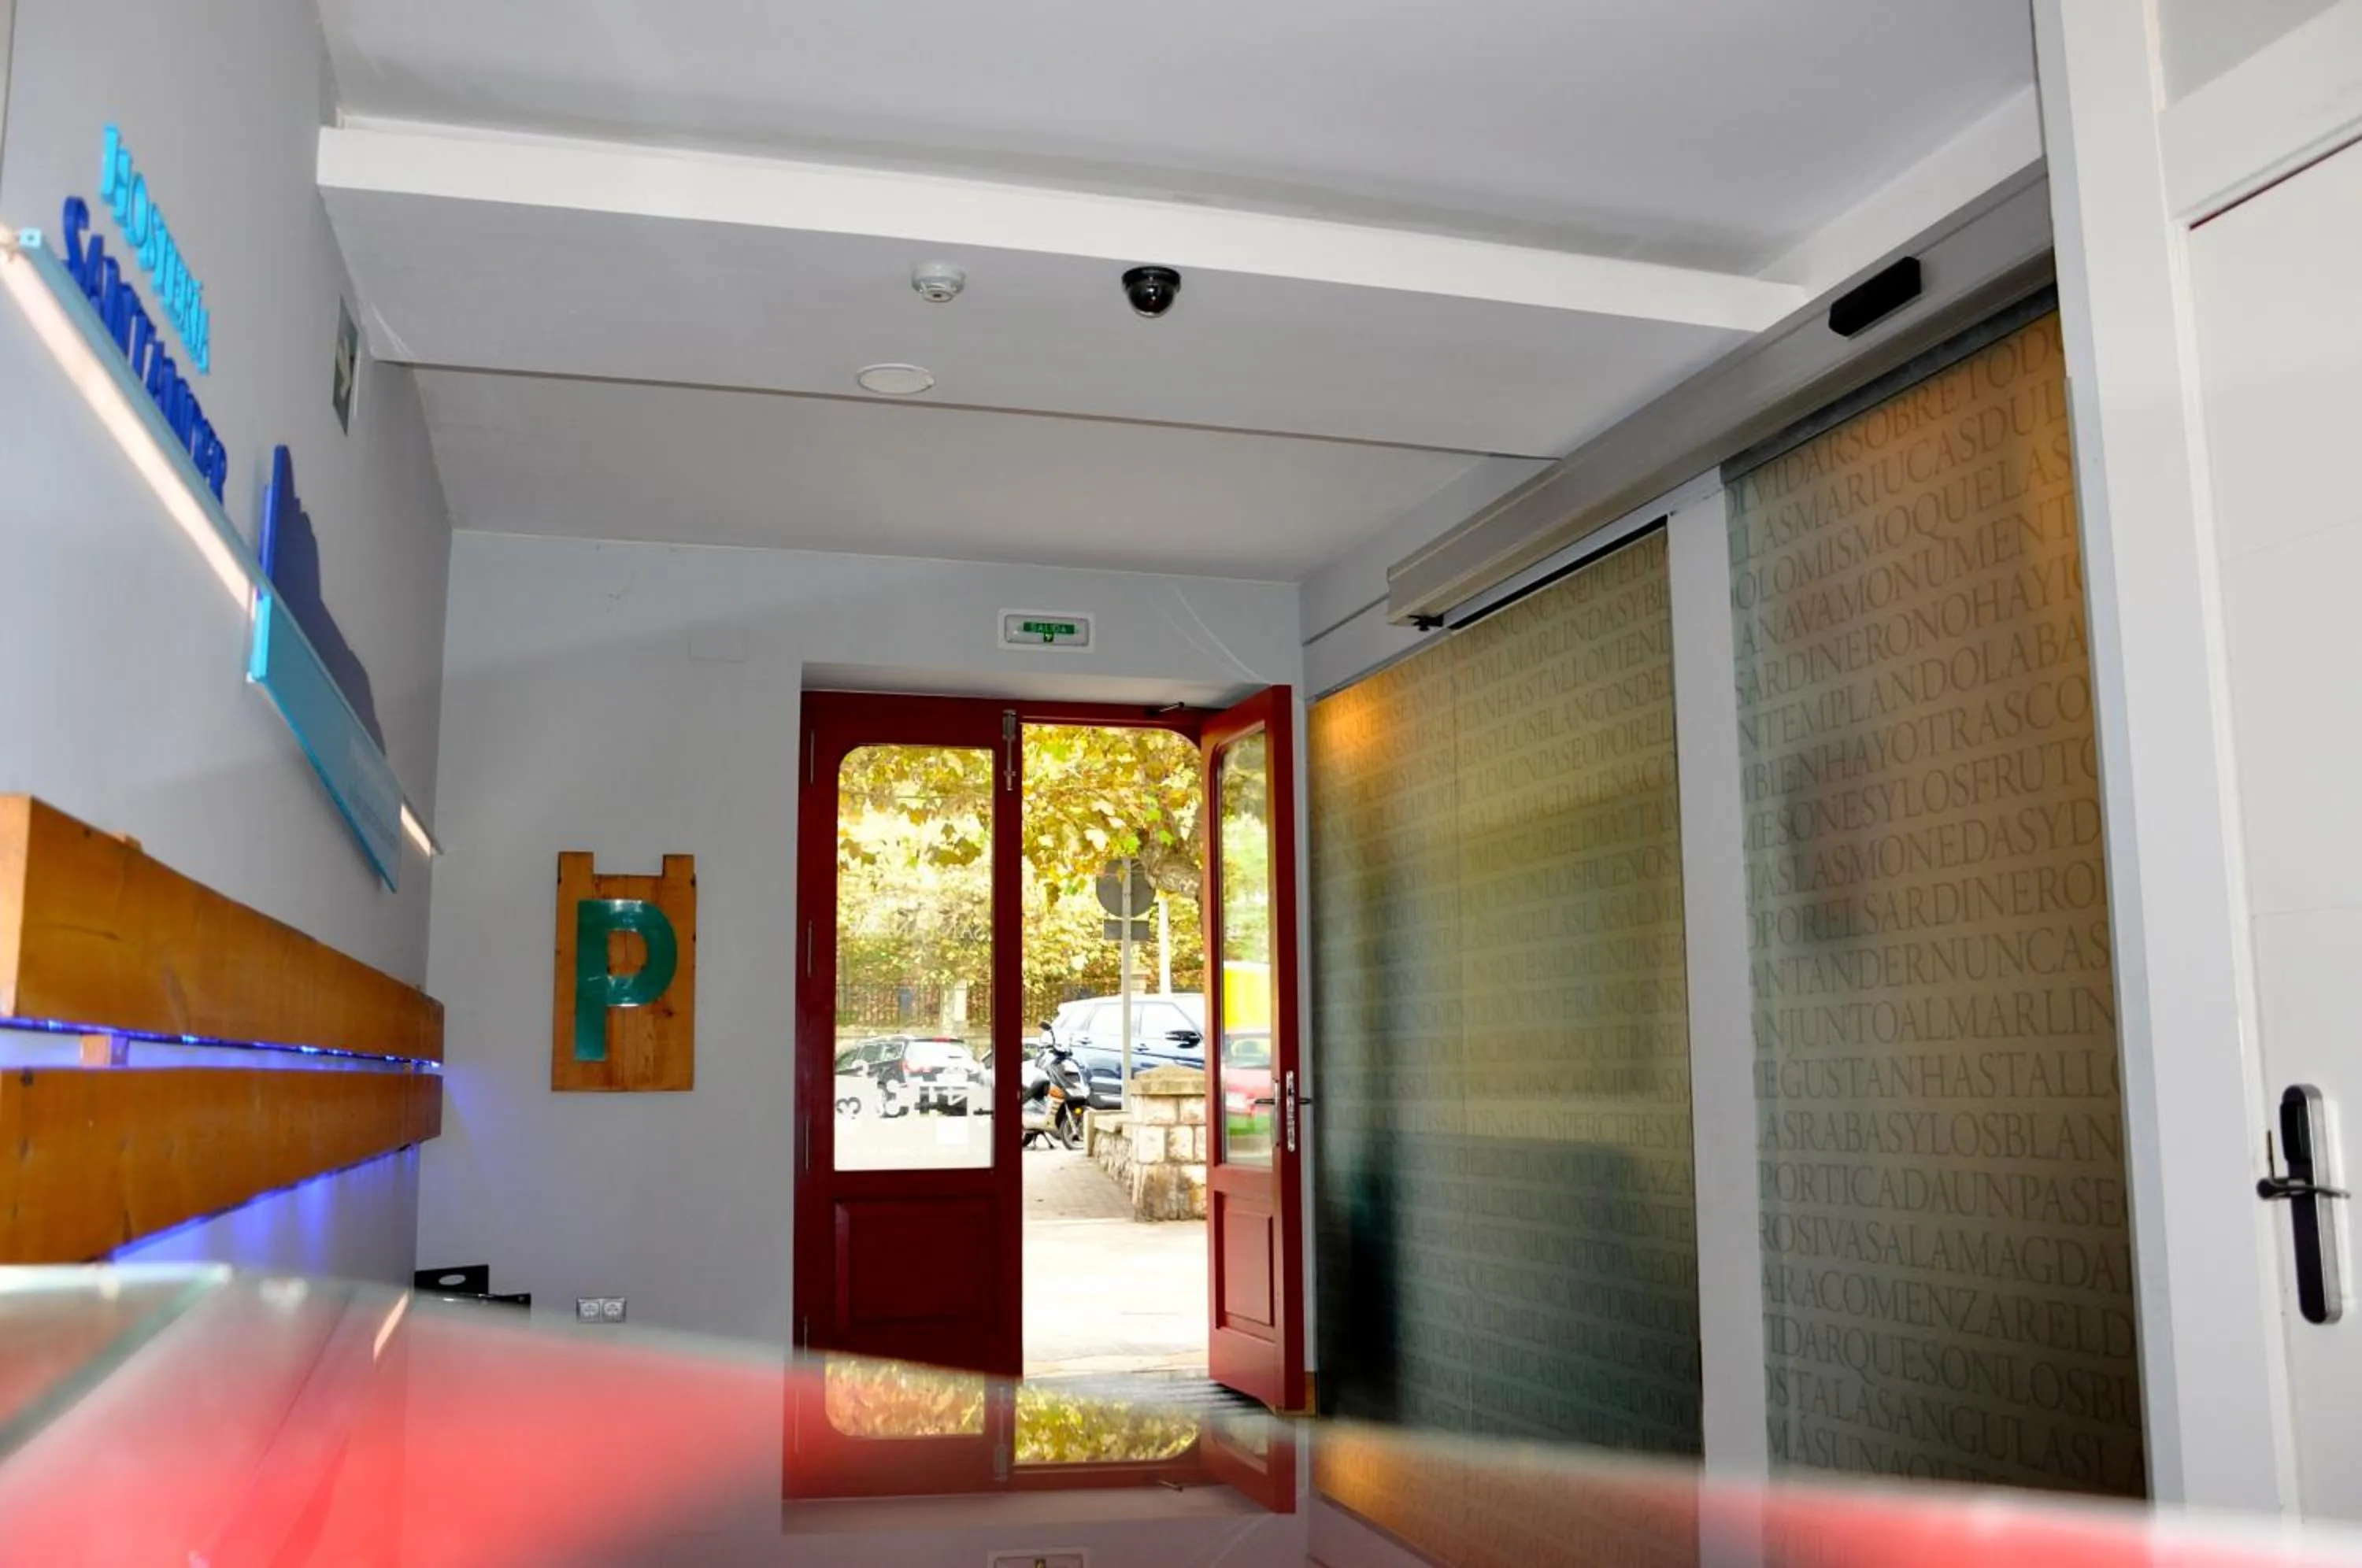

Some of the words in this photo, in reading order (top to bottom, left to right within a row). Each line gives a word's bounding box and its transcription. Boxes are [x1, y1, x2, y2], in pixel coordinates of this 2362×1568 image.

[1729, 429, 2071, 614] OLOMISMOQUELAS
[1732, 490, 2075, 661] ANAVAMONUMENT
[1744, 792, 2101, 908] JASLASMONEDASYD
[574, 899, 677, 1060] P
[1755, 1111, 2121, 1158] ASRABASYLOSBLAN
[1758, 1162, 2126, 1227] PORTICADAUNPASE
